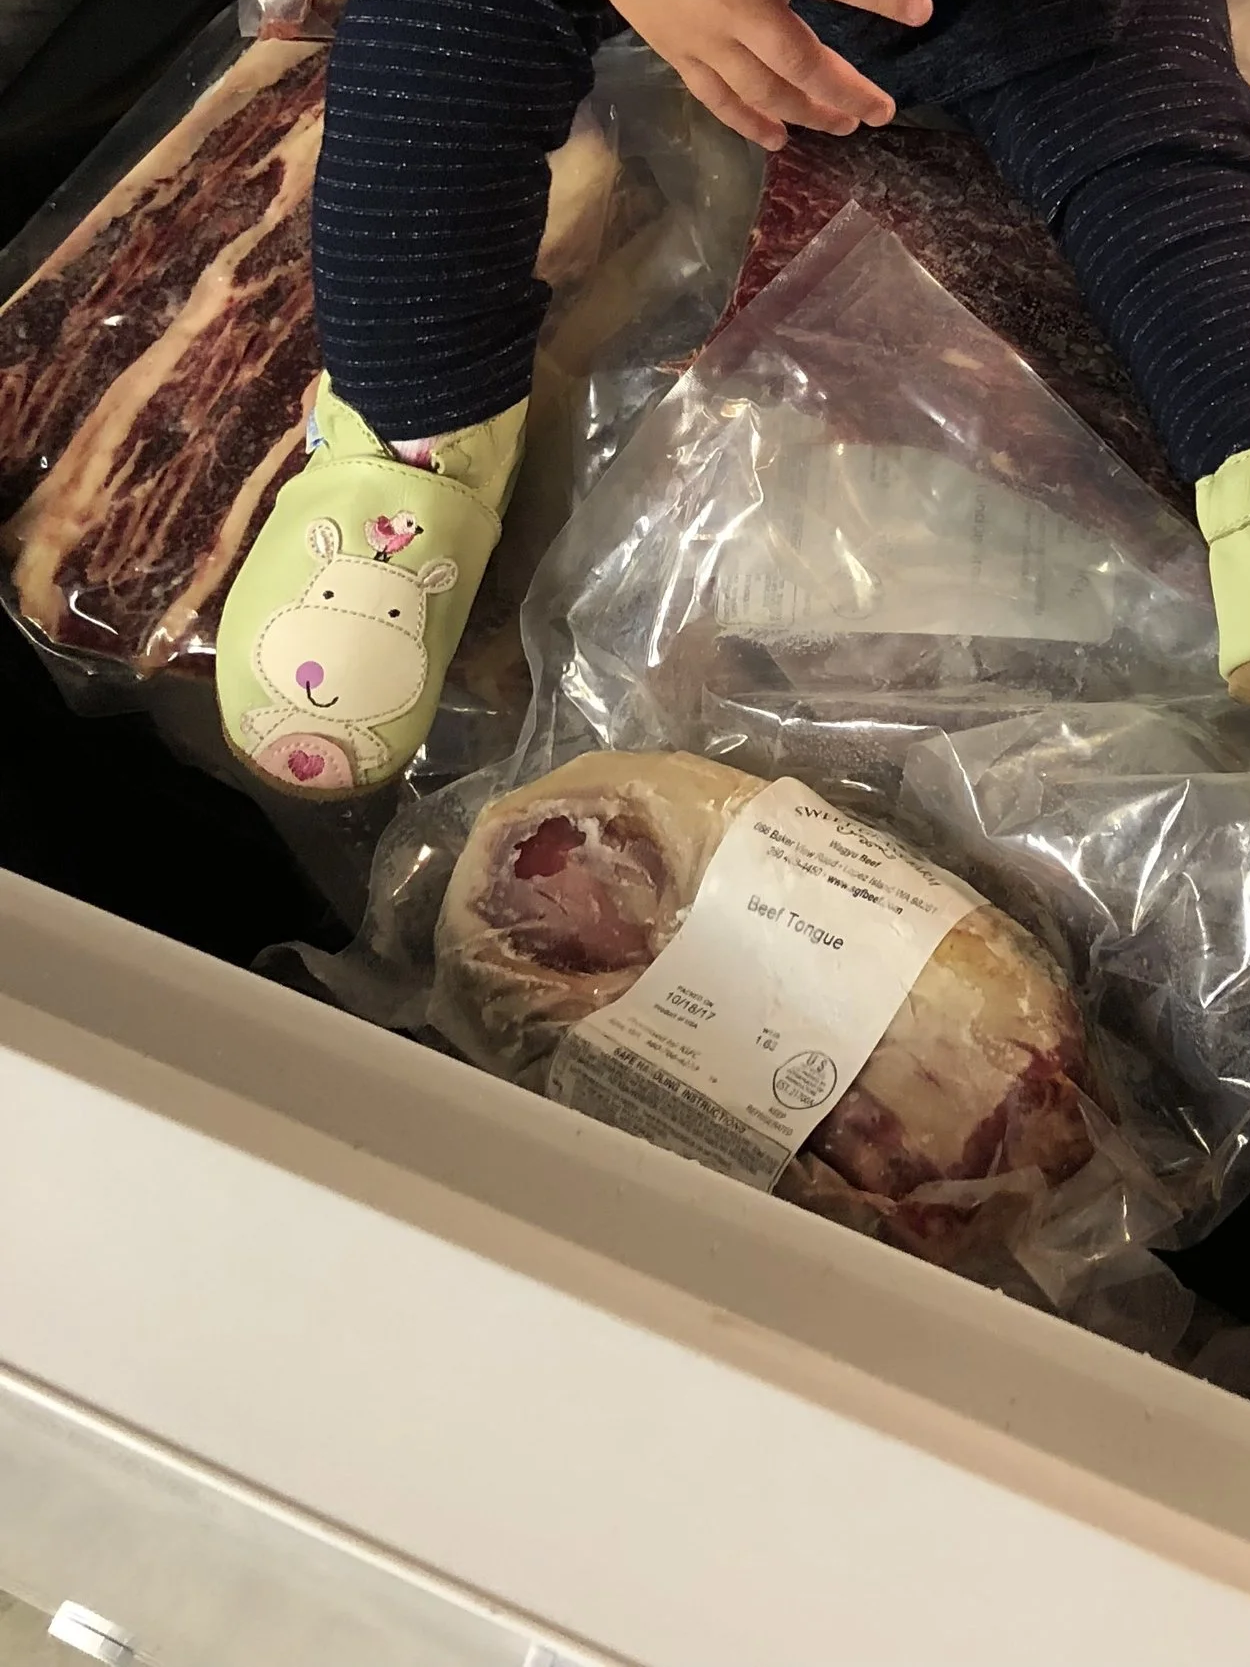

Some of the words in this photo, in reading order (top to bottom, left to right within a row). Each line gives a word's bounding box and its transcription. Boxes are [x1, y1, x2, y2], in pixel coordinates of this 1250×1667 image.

[769, 829, 796, 847] Baker
[829, 840, 859, 859] Wagyu
[858, 854, 883, 869] Beef
[747, 895, 785, 921] Beef
[786, 911, 845, 950] Tongue
[666, 991, 716, 1021] 10/18/17
